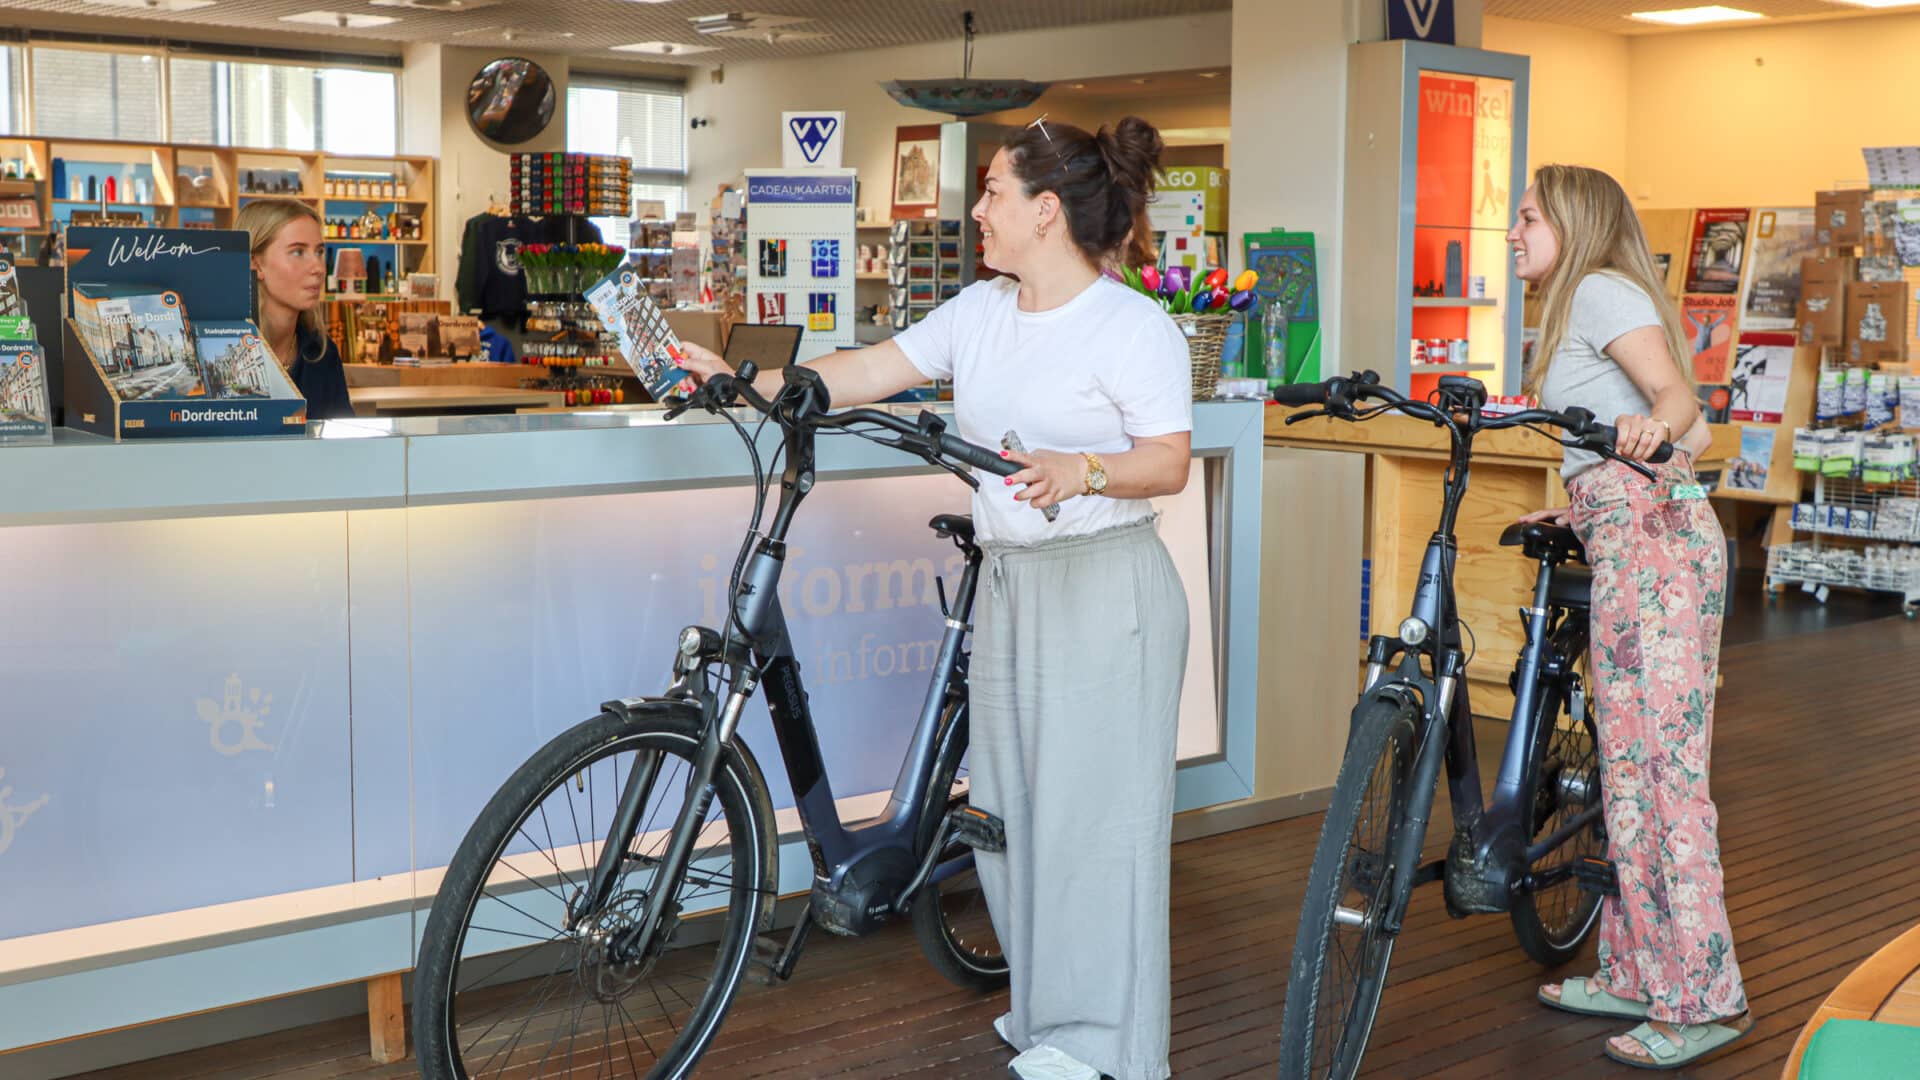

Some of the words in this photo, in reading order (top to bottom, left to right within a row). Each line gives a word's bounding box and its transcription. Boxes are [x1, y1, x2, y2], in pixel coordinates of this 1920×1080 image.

[1424, 78, 1511, 121] winkel
[750, 185, 851, 196] CADEAUKAARTEN
[108, 234, 221, 267] Welkom
[783, 666, 801, 719] PEGASUS
